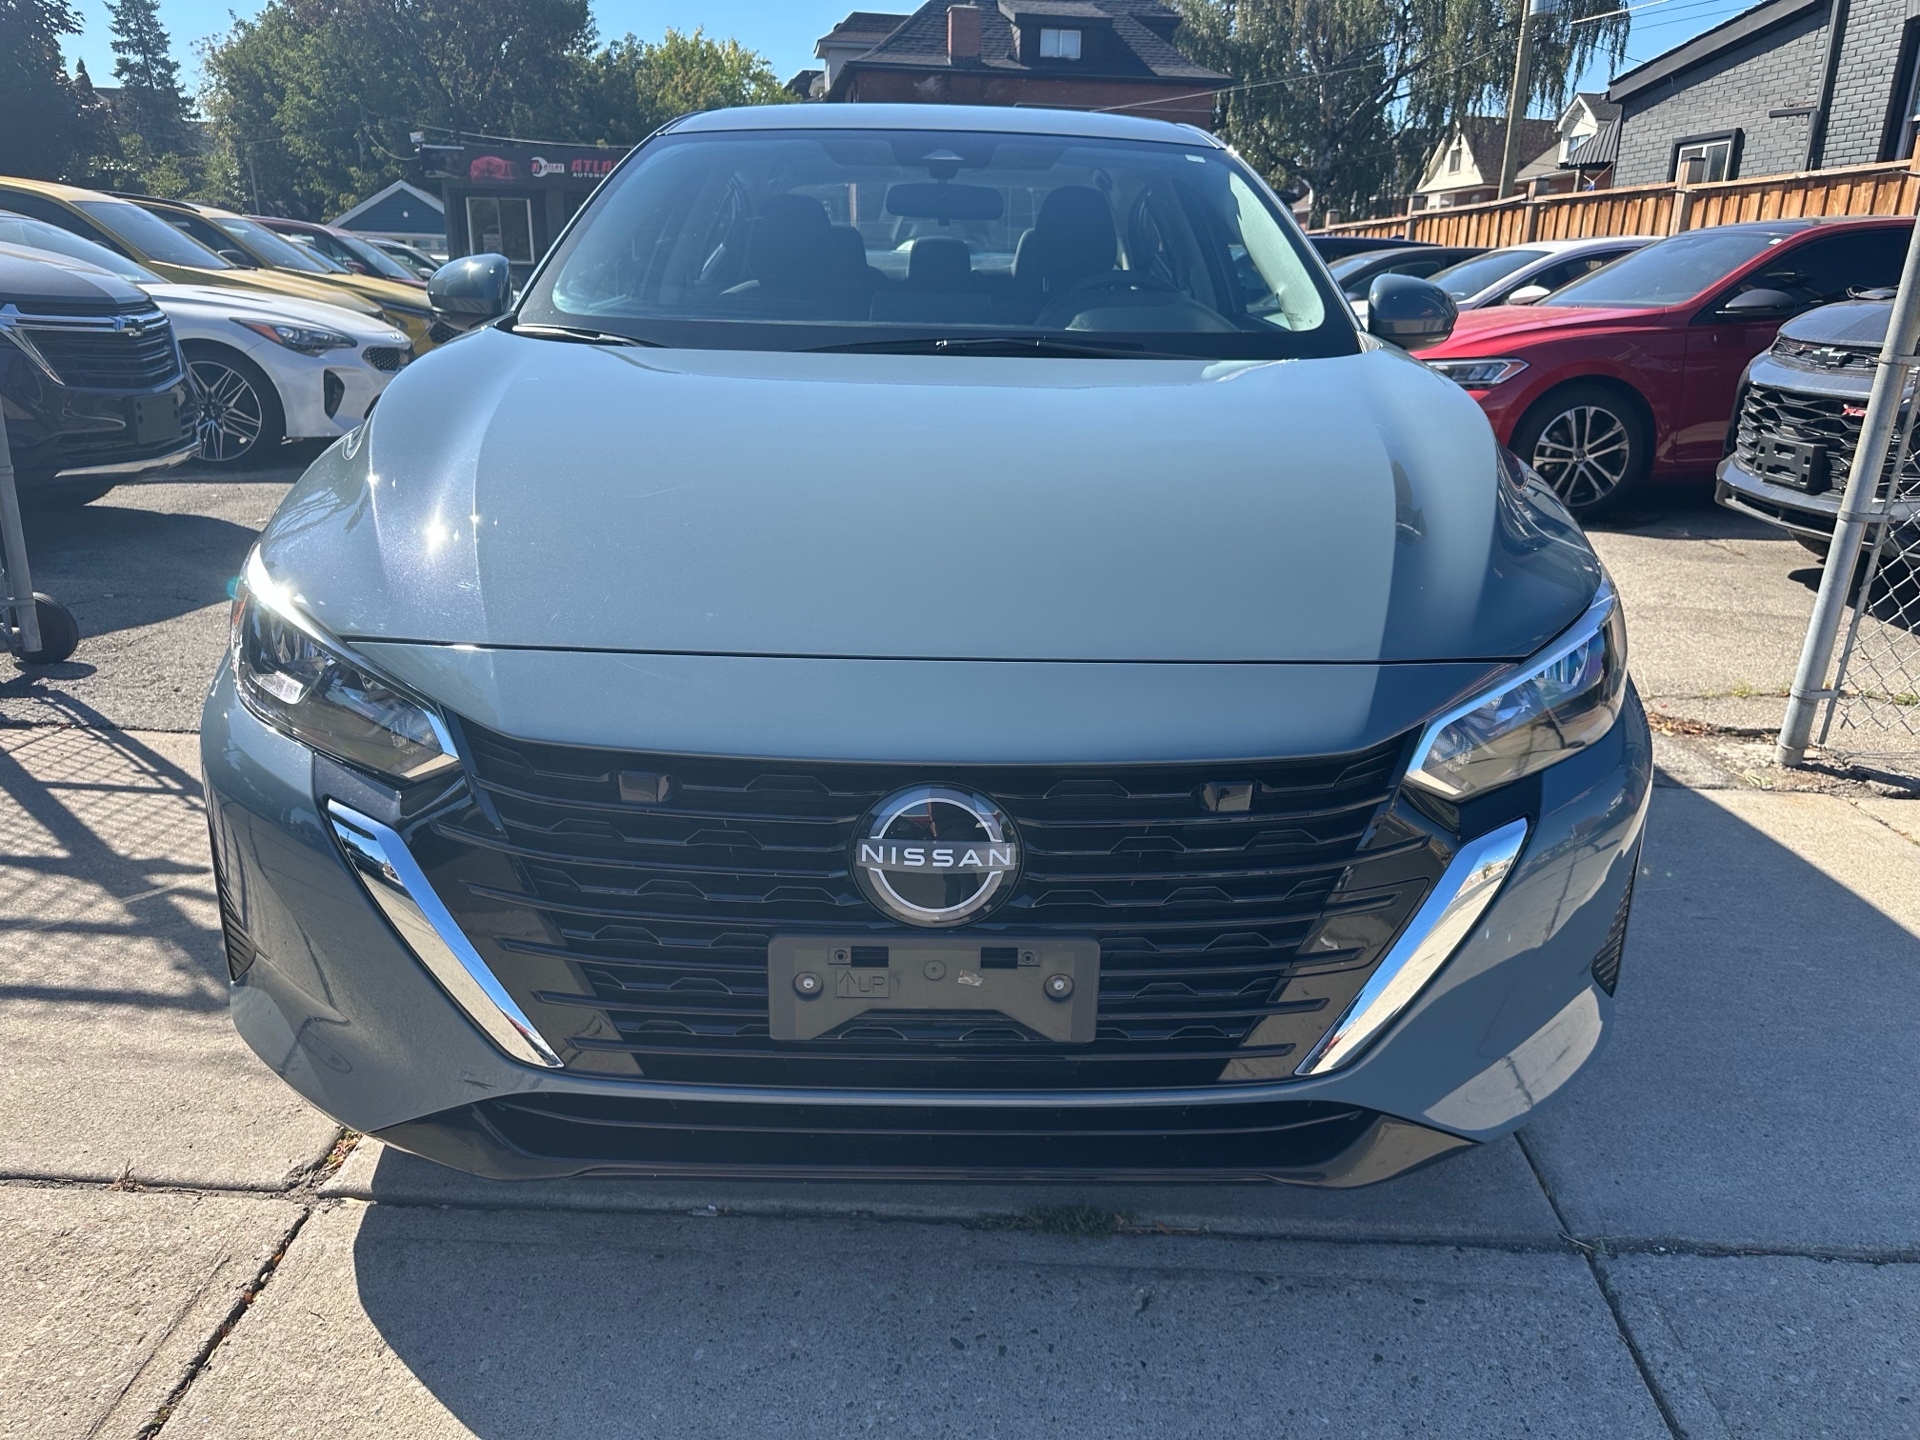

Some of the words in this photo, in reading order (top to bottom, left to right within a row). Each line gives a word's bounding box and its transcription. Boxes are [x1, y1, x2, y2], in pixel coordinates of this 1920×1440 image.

[571, 159, 618, 172] ATLA
[861, 844, 1010, 867] NISSAN
[859, 976, 885, 993] UP
